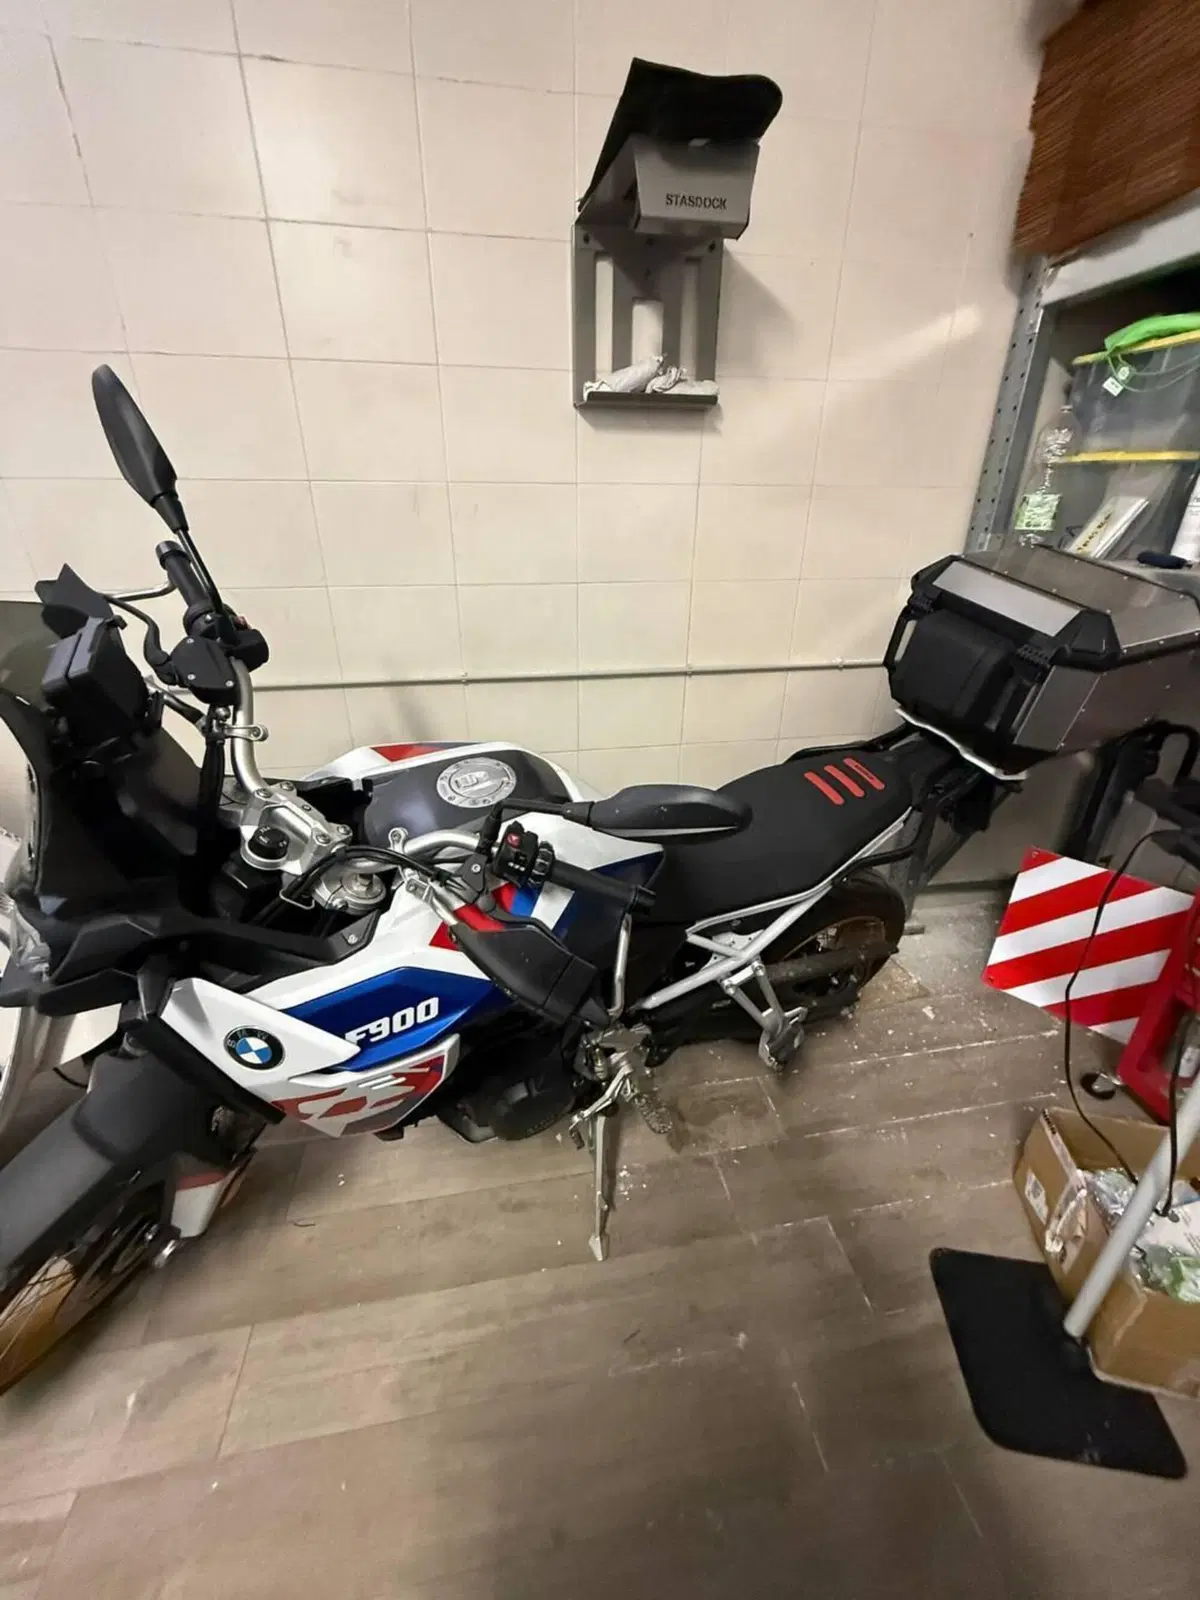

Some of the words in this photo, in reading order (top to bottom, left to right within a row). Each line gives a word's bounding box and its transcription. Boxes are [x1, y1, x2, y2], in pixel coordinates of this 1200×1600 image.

[666, 193, 728, 210] STASDOCK
[345, 997, 439, 1042] F900
[226, 1029, 269, 1048] BMW
